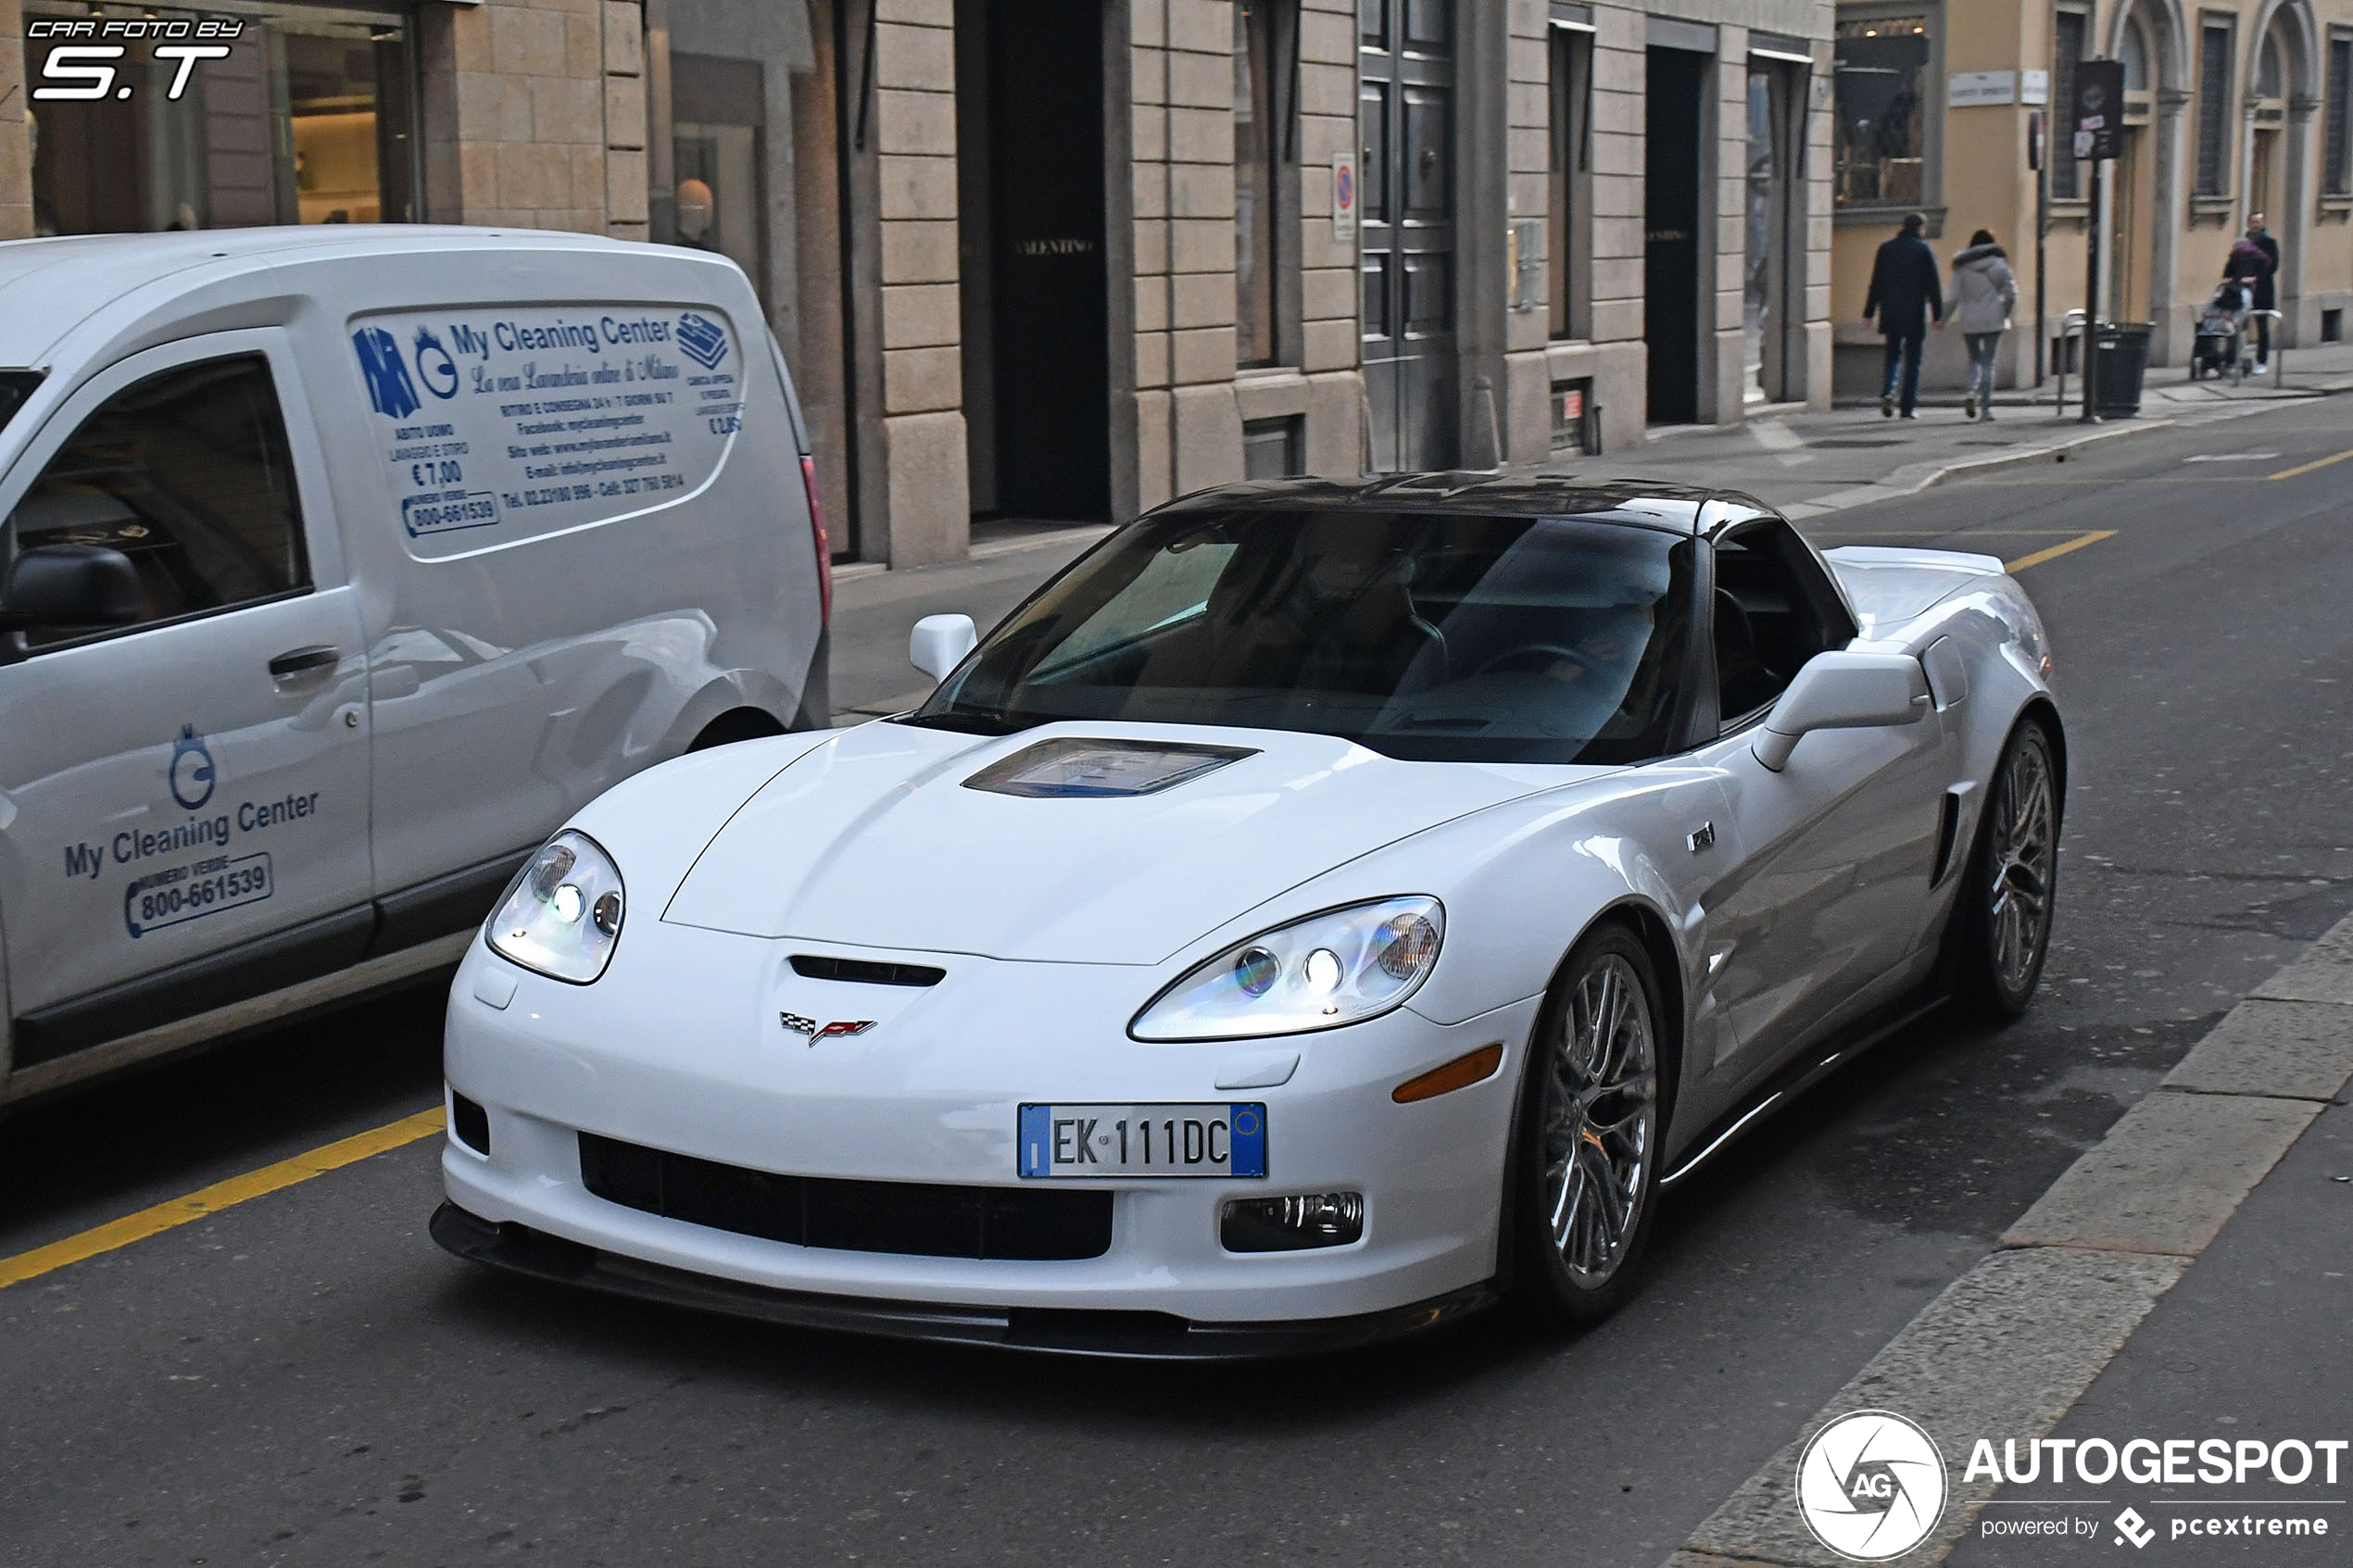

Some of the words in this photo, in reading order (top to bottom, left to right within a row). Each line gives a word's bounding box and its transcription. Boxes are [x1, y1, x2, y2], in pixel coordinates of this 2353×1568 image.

[450, 324, 489, 360] My
[494, 319, 600, 353] Cleaning
[601, 316, 672, 345] Center
[534, 402, 543, 415] E
[425, 423, 455, 438] UOMO
[411, 463, 425, 486] €
[414, 501, 494, 527] 800-661539
[65, 841, 104, 880] My
[112, 816, 230, 864] Cleaning
[238, 793, 319, 832] Center
[142, 865, 265, 921] 800-661539
[1053, 1119, 1099, 1164] EK
[1115, 1119, 1229, 1164] 111DC
